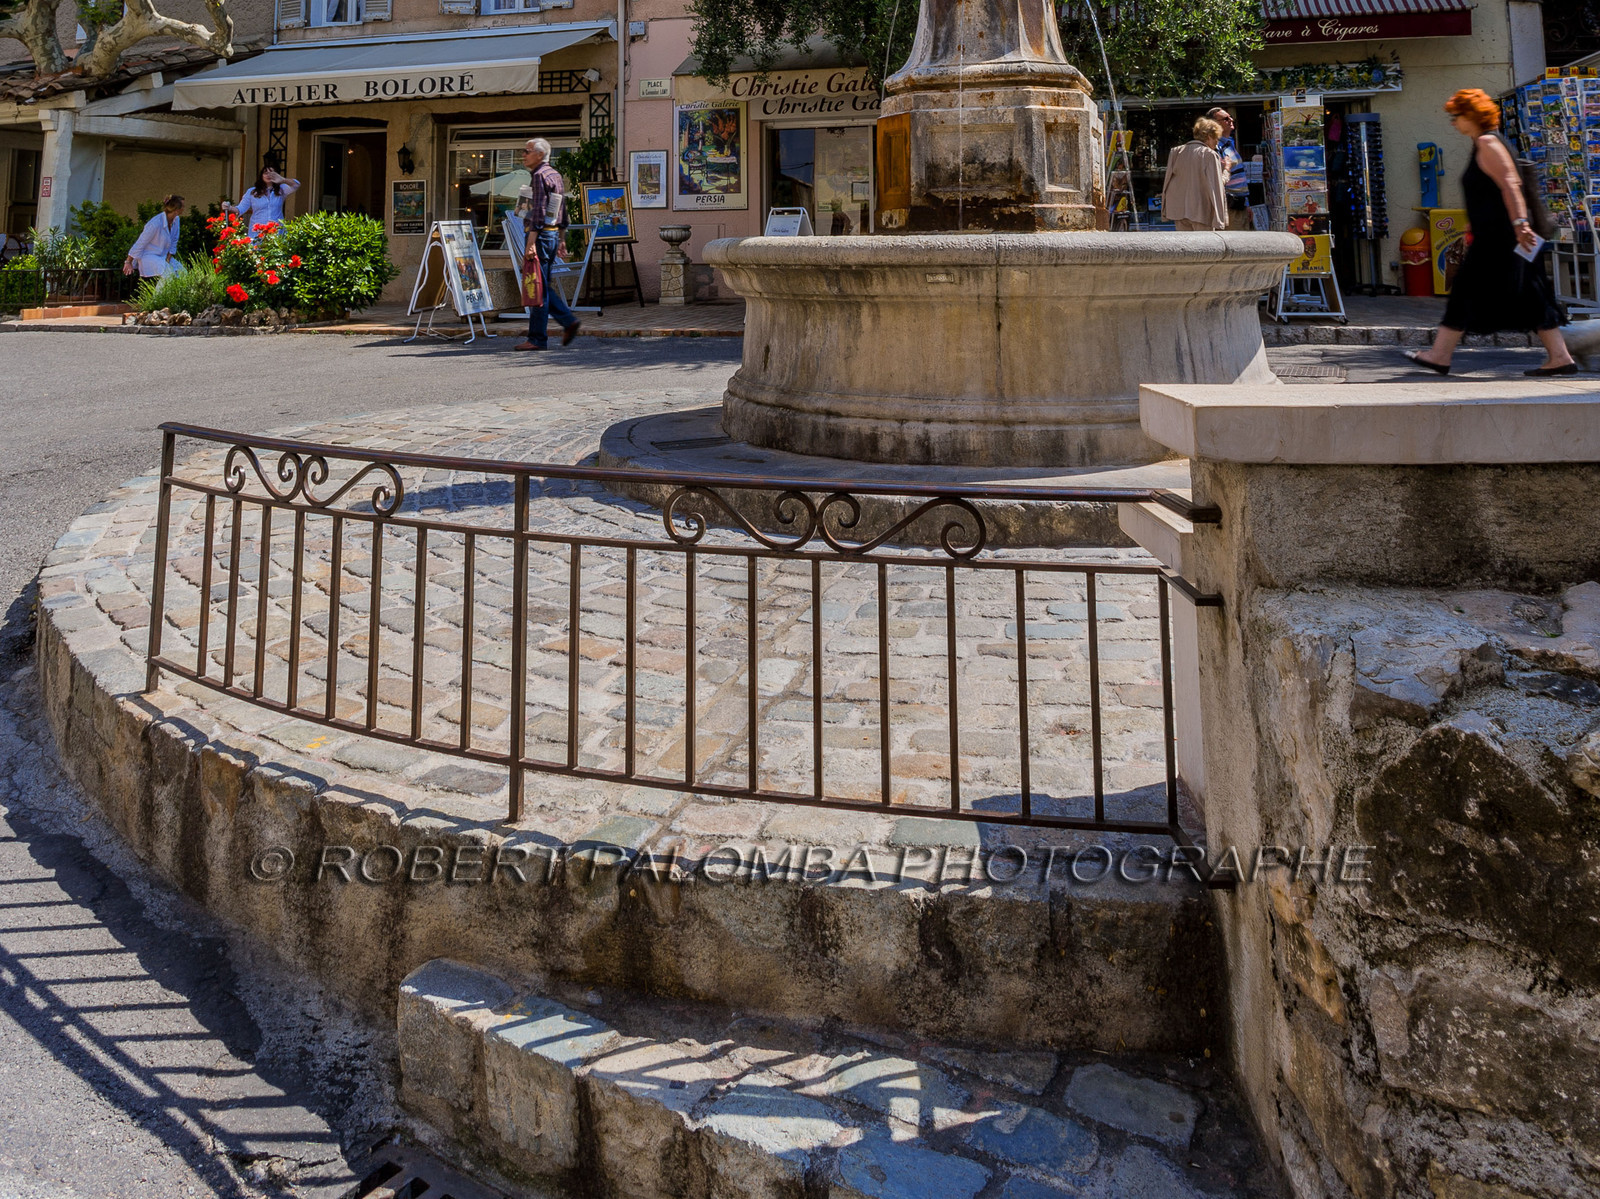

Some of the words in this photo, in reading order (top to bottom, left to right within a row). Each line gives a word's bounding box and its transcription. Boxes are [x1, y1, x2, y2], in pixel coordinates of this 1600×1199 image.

[1301, 25, 1311, 37] à
[1317, 18, 1379, 41] Cigares
[231, 83, 338, 105] ATELIER
[364, 71, 475, 97] BOLORÉ
[647, 80, 663, 88] PLACE
[732, 74, 819, 97] Christie
[762, 97, 844, 115] Christie
[695, 195, 725, 204] PERSIA
